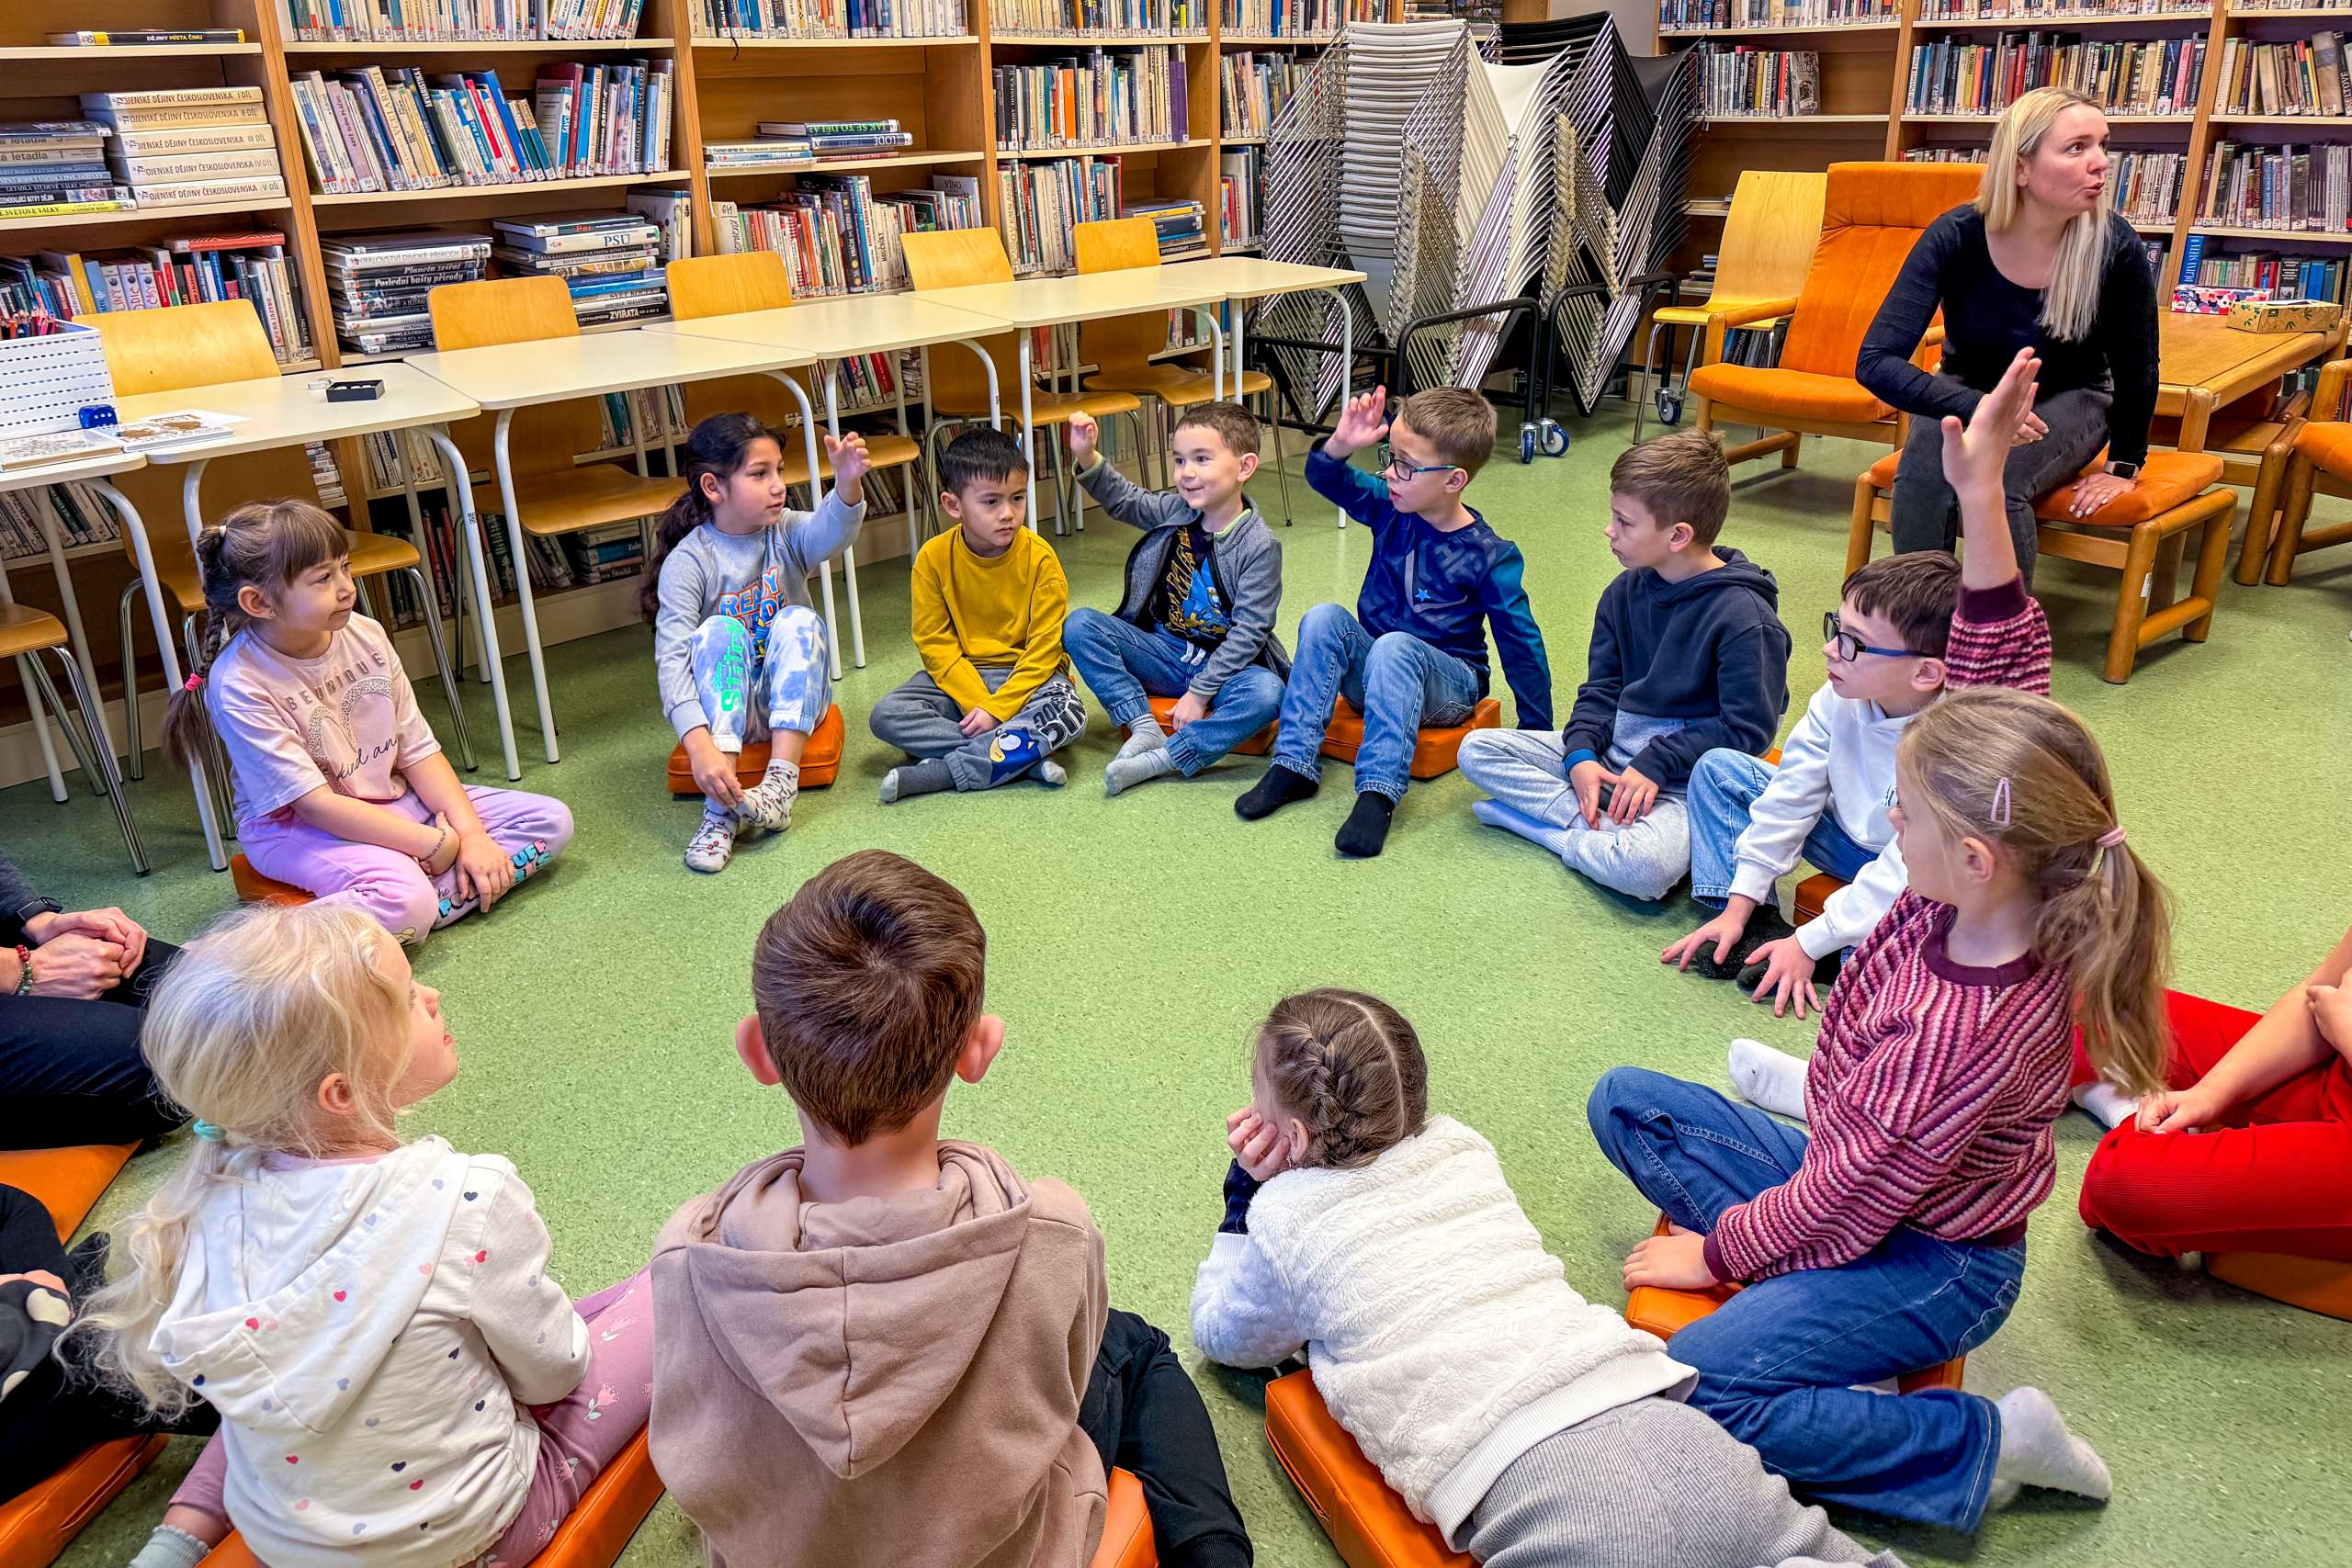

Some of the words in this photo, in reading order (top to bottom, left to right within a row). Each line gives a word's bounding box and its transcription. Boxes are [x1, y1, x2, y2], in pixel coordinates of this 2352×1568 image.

[124, 95, 151, 105] JENSKÉ
[153, 94, 175, 103] DĚJINY
[130, 111, 157, 123] OJENSKÉ
[159, 110, 182, 121] DĚJINY
[138, 138, 164, 150] JENSKÉ
[164, 136, 187, 148] DĚJINY
[12, 151, 48, 161] letadla
[145, 164, 173, 176] OJENSKÉ
[175, 164, 198, 175] DĚJINY
[149, 188, 176, 200] OJENSKÉ
[178, 186, 200, 198] DĚJINY
[718, 567, 780, 617] REAY
[336, 748, 368, 782] kind
